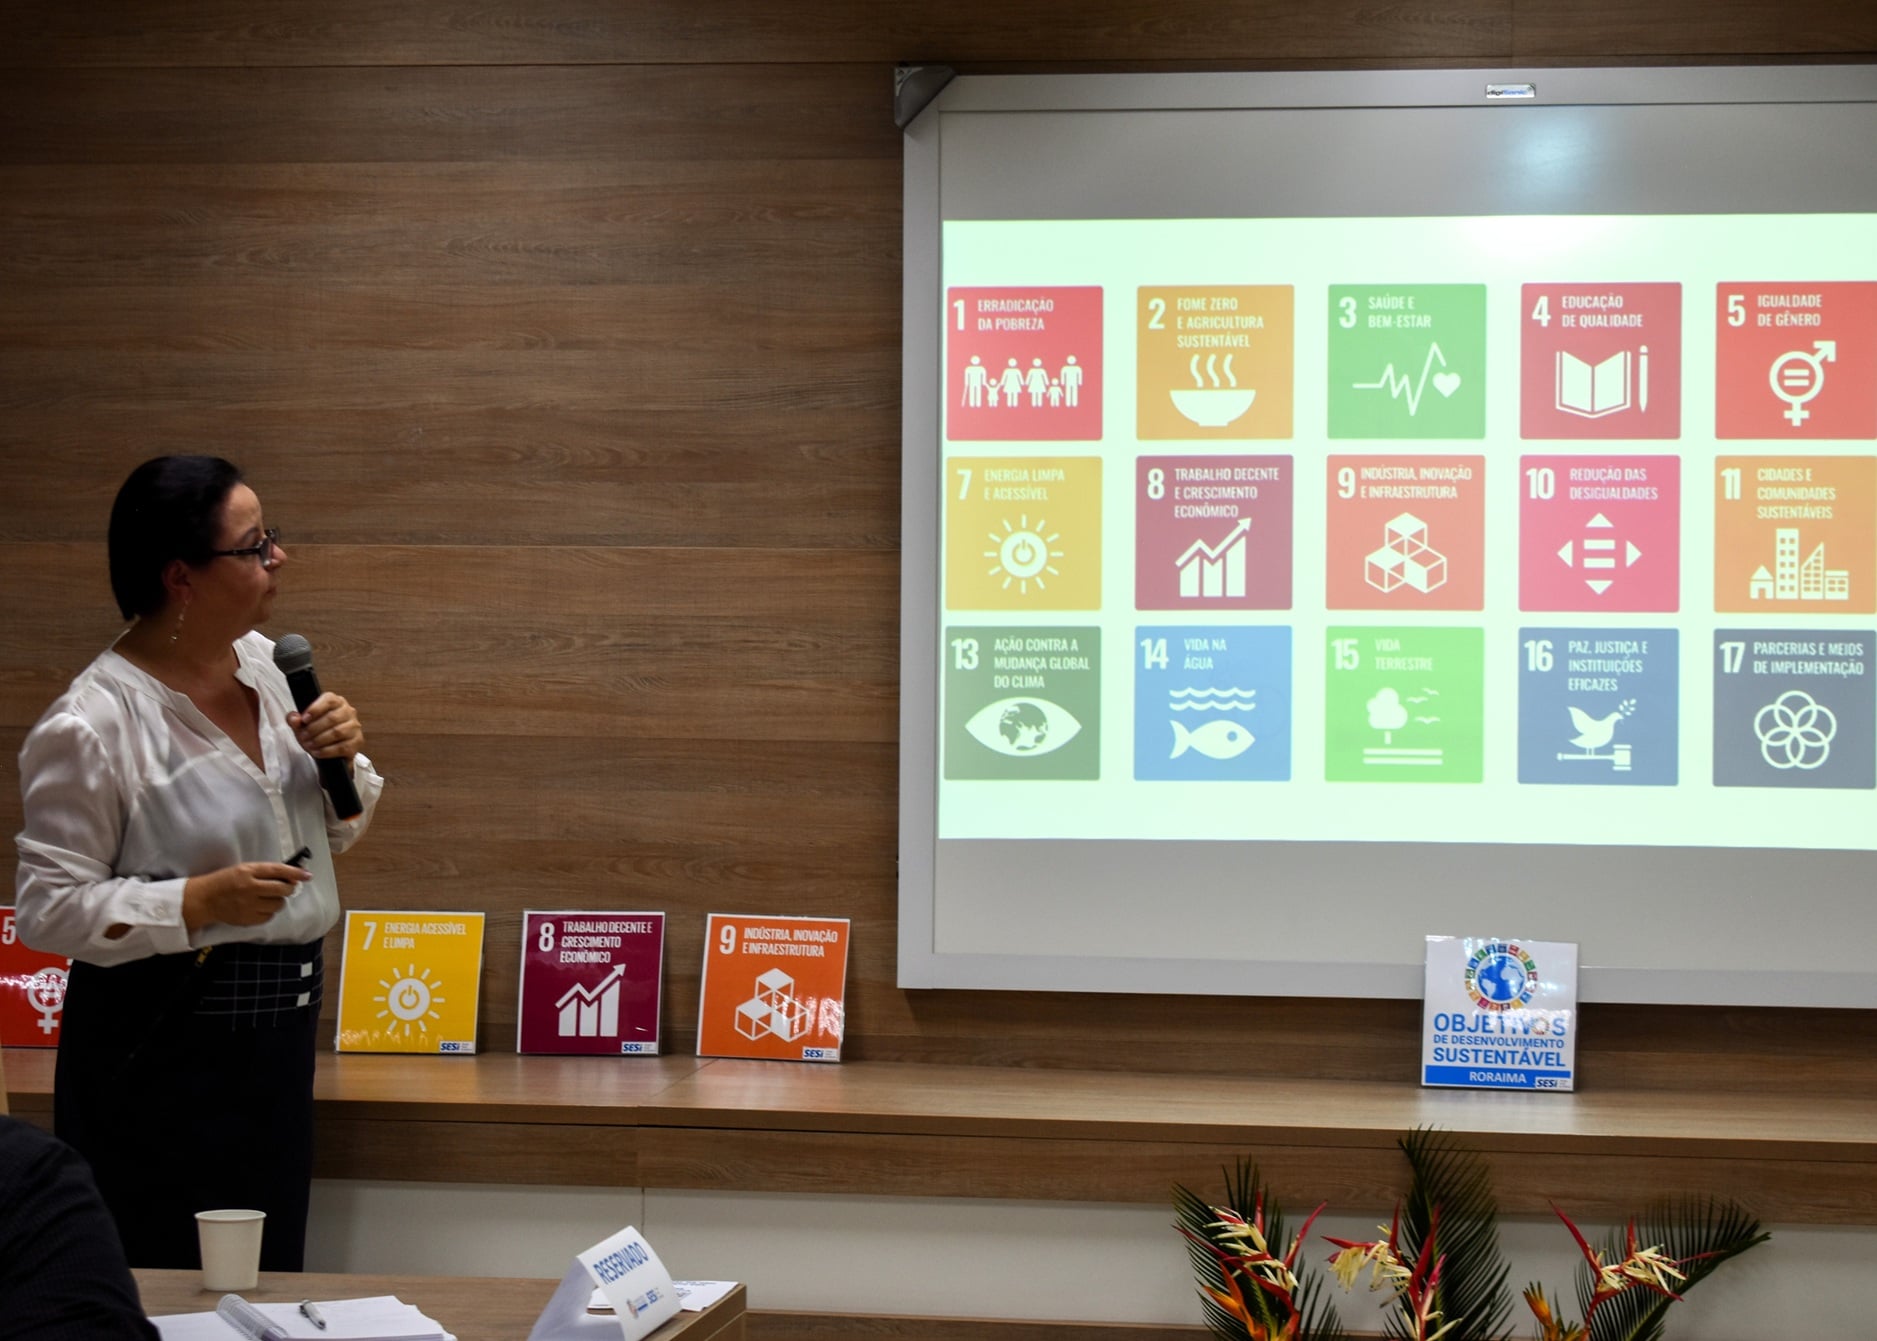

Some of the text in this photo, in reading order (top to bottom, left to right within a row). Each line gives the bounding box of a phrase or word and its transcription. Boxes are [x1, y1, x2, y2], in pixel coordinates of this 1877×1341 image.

[978, 297, 1054, 315] ERRADICAÇÃO
[1177, 298, 1238, 311] FOME ZERO
[1369, 293, 1415, 309] SAÚDE E
[1562, 293, 1623, 311] EDUCAÇÃO
[1758, 294, 1821, 307] IGUALDADE
[954, 300, 965, 330] 1
[1148, 298, 1165, 329] 2
[1339, 297, 1356, 328] 3
[1532, 296, 1551, 327] 4
[1728, 295, 1745, 326] 5
[978, 318, 1044, 330] DA POBREZA
[1177, 316, 1263, 329] E AGRICULTURA
[1369, 315, 1431, 328] BEM-ESTAR
[1563, 314, 1643, 328] DE QUALIDADE
[1758, 311, 1821, 326] DE GÊNERO
[1177, 332, 1250, 347] SUSTENTÁVEL
[984, 469, 1065, 481] ENERGIA LIMPA
[1175, 468, 1279, 481] TRABALHO DECENTE
[1420, 464, 1472, 483] INOVAÇÃO
[1570, 466, 1646, 484] REDUÇÃO DAS
[1757, 468, 1812, 481] CIDADES E
[957, 469, 972, 500] 7
[1148, 468, 1164, 499] 8
[1338, 467, 1355, 498] 9
[1526, 468, 1554, 499] 10
[1721, 468, 1741, 499] 11
[984, 488, 990, 500] E
[1175, 487, 1257, 499] E CRESCIMENTO
[1361, 486, 1458, 498] E INFRAESTRUTURA
[1570, 487, 1658, 499] DESIGUALDADES
[1757, 487, 1836, 500] COMUNIDADES
[1175, 503, 1238, 517] ECONÔMICO
[1757, 503, 1832, 519] SUSTENTÁVEIS
[995, 636, 1078, 654] AÇÃO CONTRA A
[1184, 639, 1226, 651] VIDA NA
[1375, 639, 1400, 651] VIDA
[1595, 641, 1638, 659] JUSTIÇA
[1642, 641, 1648, 654] E
[1754, 642, 1863, 656] PARCERIAS E MEIOS
[951, 638, 979, 669] 13
[1141, 638, 1169, 669] 14
[1332, 638, 1359, 670] 15
[1524, 640, 1553, 671] 16
[1720, 642, 1745, 673] 17
[994, 657, 1089, 673] MUDANÇA GLOBAL
[1184, 655, 1213, 669] ÁGUA
[1375, 658, 1432, 670] TERRESTRE
[1754, 659, 1863, 678] DE IMPLEMENTAÇÃO
[994, 675, 1045, 688] DO CLIMA
[1568, 678, 1617, 691] EFICAZES
[2, 917, 16, 944] 5
[385, 922, 466, 935] ENERGIA ACESSÍVEL
[563, 922, 652, 933] TRABALHO DECENTE E
[363, 922, 376, 950] 7
[390, 938, 414, 948] LIMPA
[539, 923, 554, 951] 8
[562, 937, 621, 947] CRESCIMENTO
[720, 925, 736, 954] 9
[794, 929, 838, 943] INOVAÇÃO
[560, 950, 611, 962] ECONÔMICO
[743, 944, 824, 957] E INFRAESTRUTURA
[1434, 1035, 1564, 1048] DE DESENVOLVIMENTO
[1434, 1046, 1565, 1067] SUSTENTÁVEL
[1469, 1072, 1527, 1083] RORAIMA
[593, 1242, 649, 1284] RESERVADO
